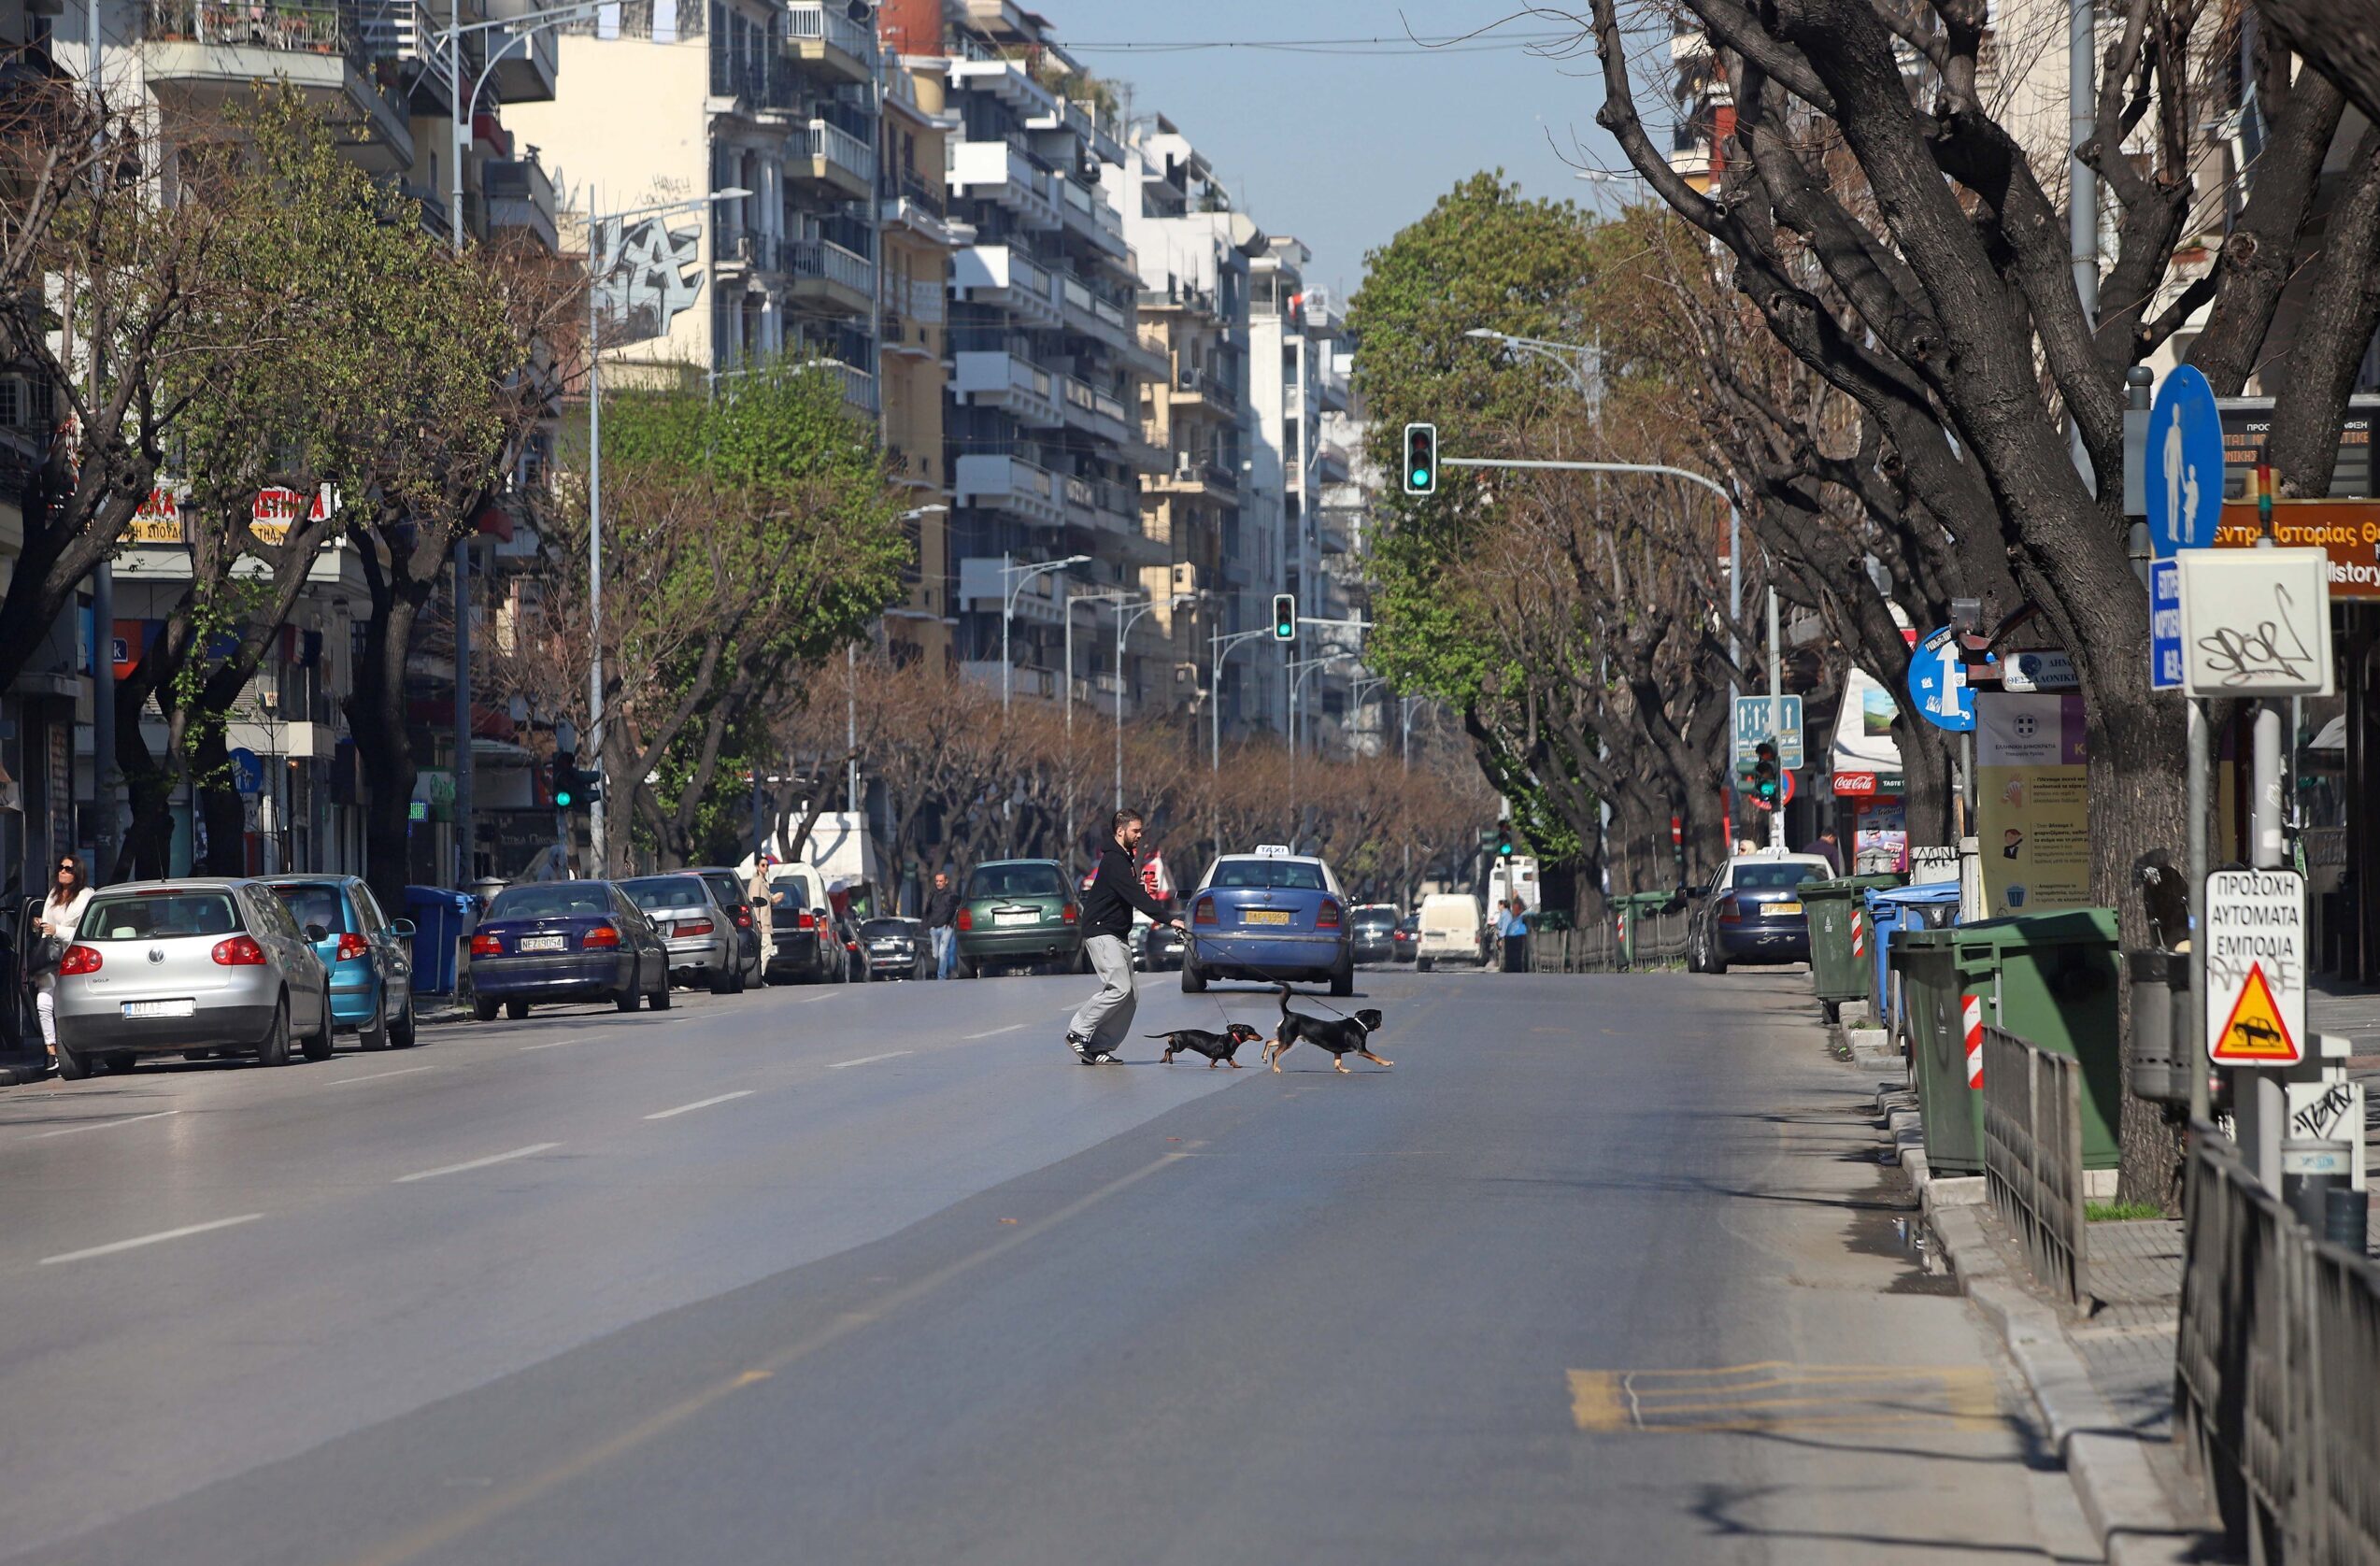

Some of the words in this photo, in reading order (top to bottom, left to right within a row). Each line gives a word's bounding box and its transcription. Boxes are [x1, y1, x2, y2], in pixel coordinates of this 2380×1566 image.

[2217, 876, 2295, 896] ΠΡΟΣΟΧΗ
[2212, 905, 2299, 926] ΑΥΤΟΜΑΤΑ
[2217, 936, 2294, 956] ΕΜΠΟΔΙΑ
